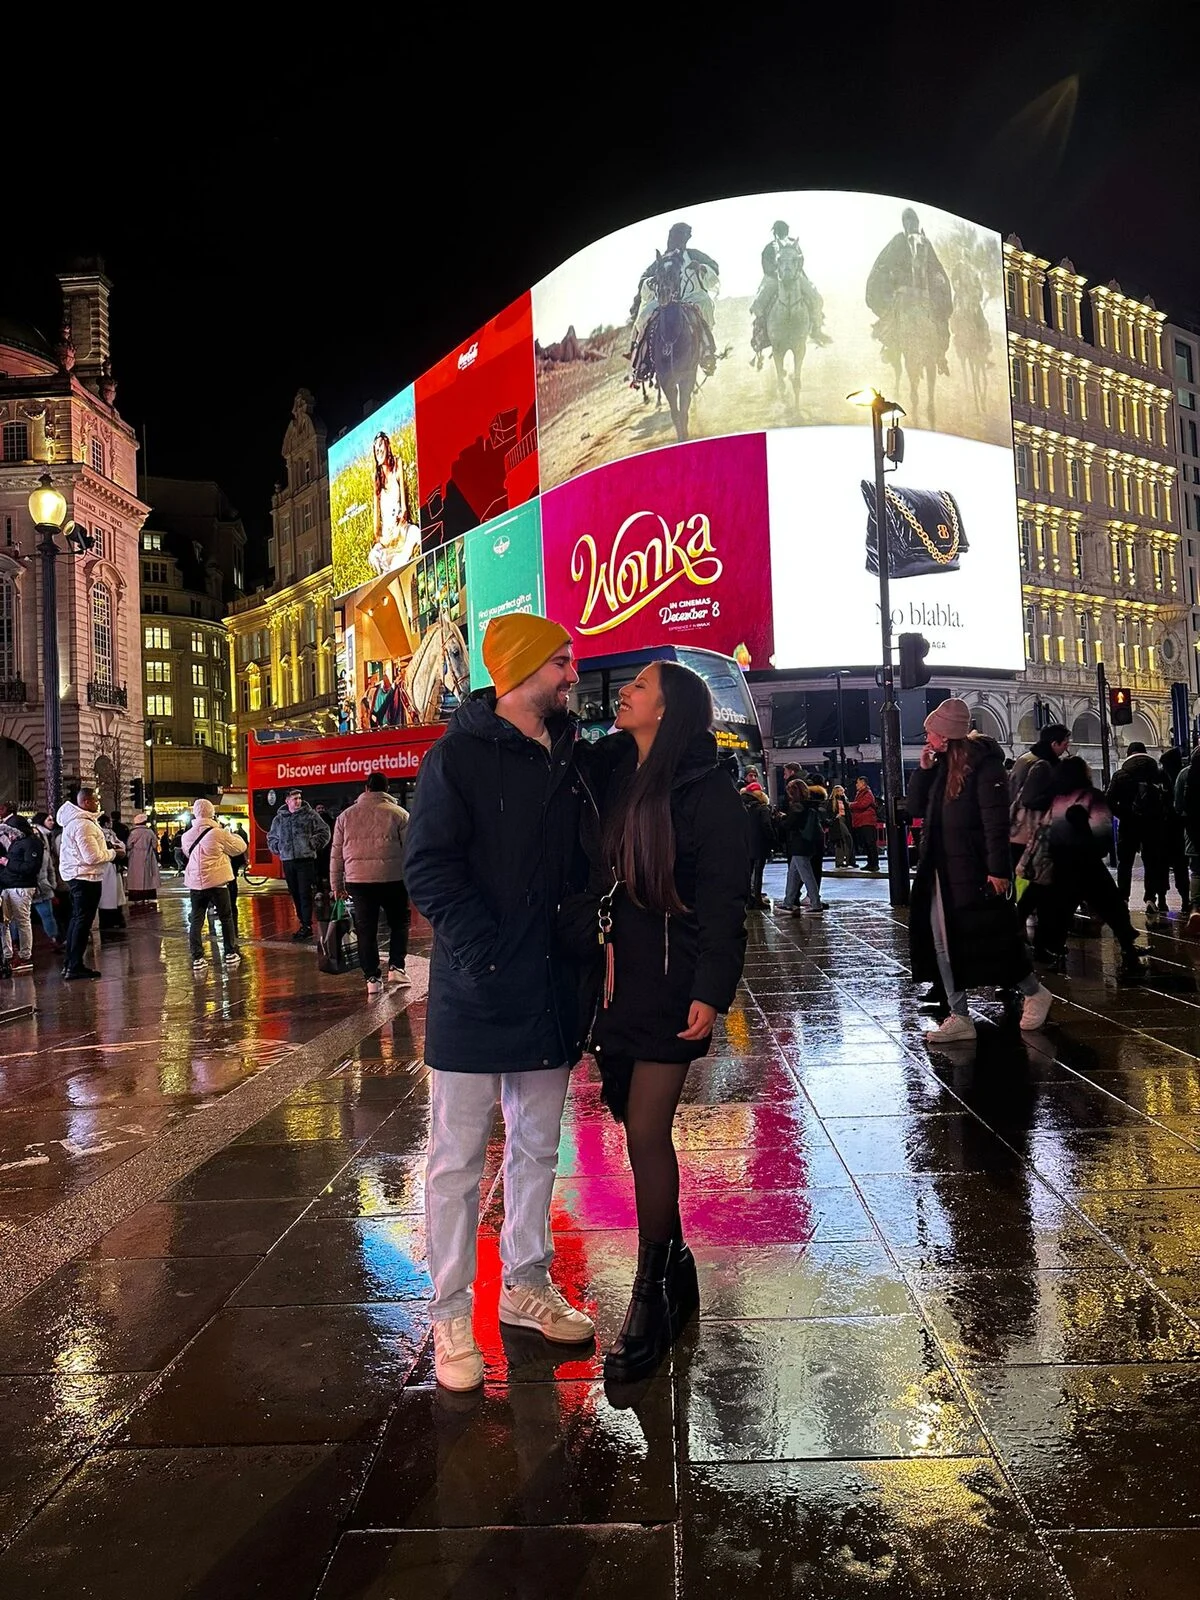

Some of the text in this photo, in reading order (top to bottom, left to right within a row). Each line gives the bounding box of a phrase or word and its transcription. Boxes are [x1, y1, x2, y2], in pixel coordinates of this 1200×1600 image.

[571, 511, 723, 634] Wonka
[659, 601, 720, 625] December 8
[679, 597, 711, 608] CINEMAS
[910, 601, 964, 627] blabla.
[277, 750, 419, 779] Discover unforgettable
